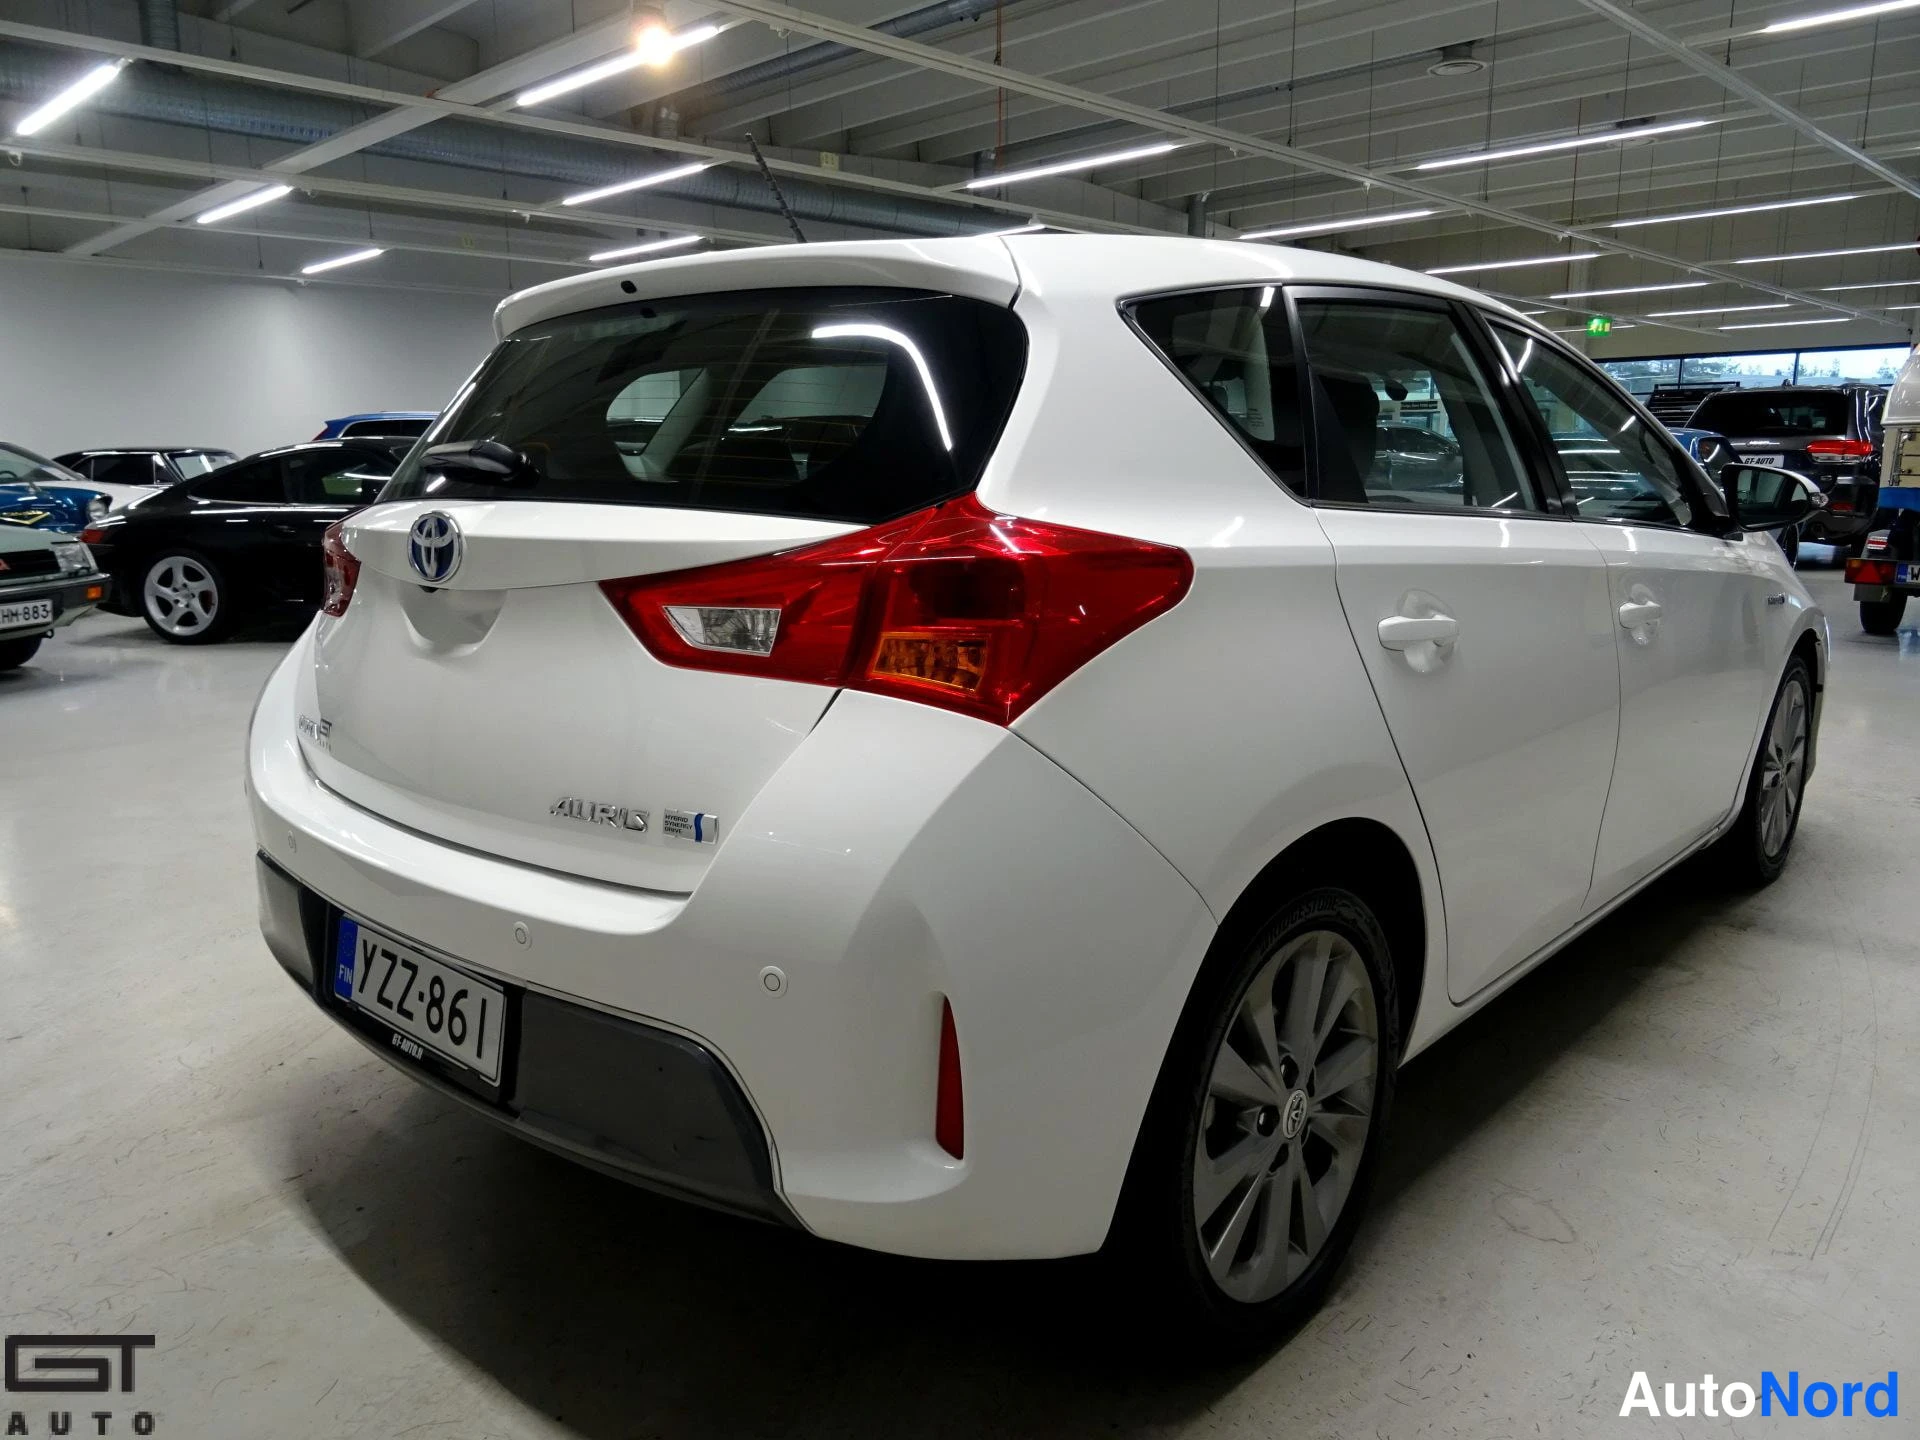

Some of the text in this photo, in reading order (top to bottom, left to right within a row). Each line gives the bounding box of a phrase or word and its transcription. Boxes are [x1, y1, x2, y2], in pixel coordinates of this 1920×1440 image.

[1744, 457, 1775, 465] GT-AUTO
[0, 603, 49, 624] HM-883
[549, 797, 650, 833] AURIS
[664, 814, 689, 823] HYBRID
[664, 820, 693, 830] SYNERGY
[338, 963, 353, 985] FIN
[358, 938, 487, 1060] YZZ-861
